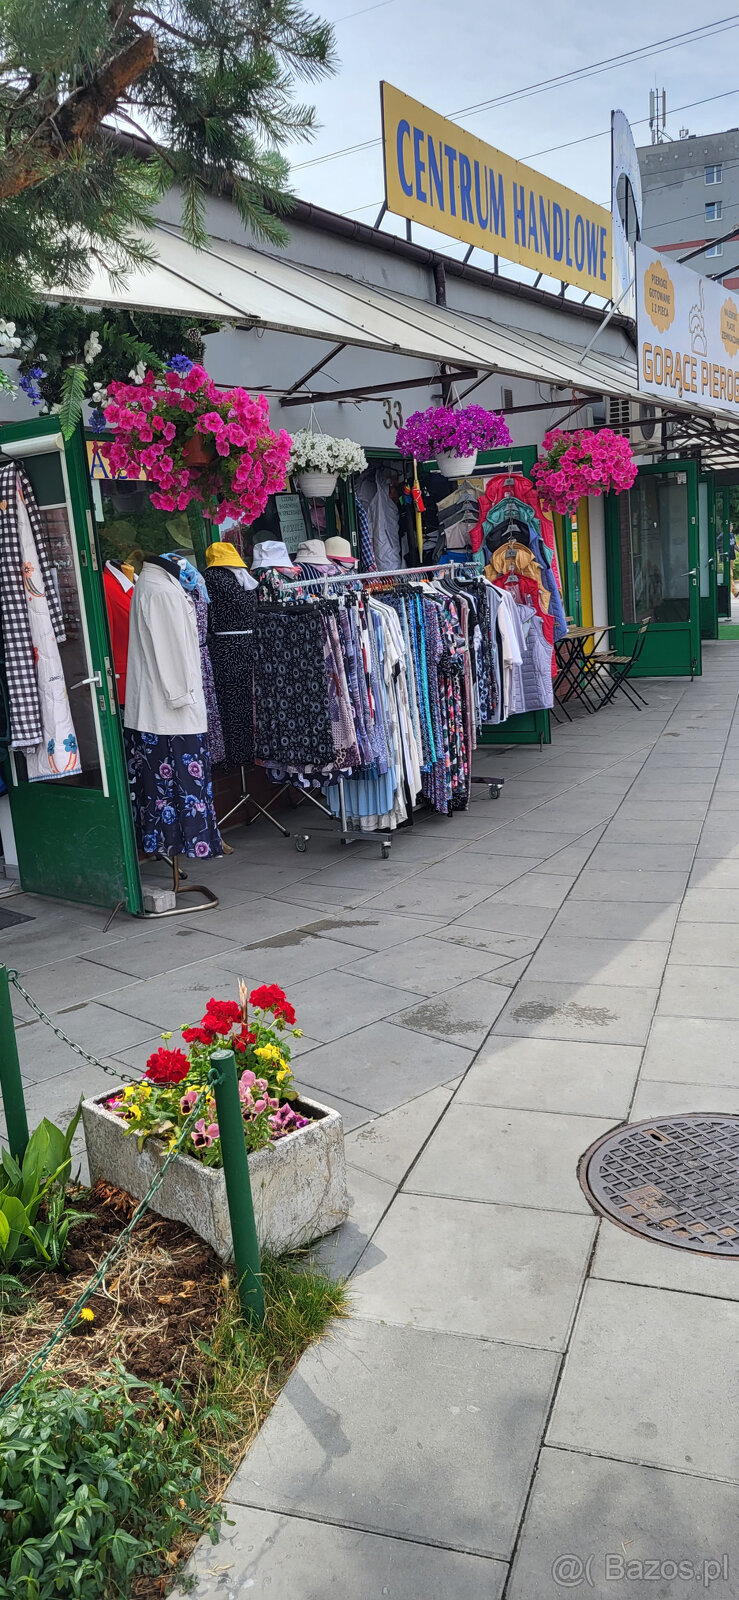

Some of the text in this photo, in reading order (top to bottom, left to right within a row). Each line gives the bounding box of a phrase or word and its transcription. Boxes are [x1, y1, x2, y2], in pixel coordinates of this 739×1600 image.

[397, 119, 607, 281] CENTRUM HANDLOWE
[651, 274, 668, 290] PIEROGI
[648, 288, 671, 305] GOTOWANE
[657, 305, 669, 317] PIECA
[642, 342, 739, 404] GORĄCE PIEROG
[382, 399, 404, 430] 33
